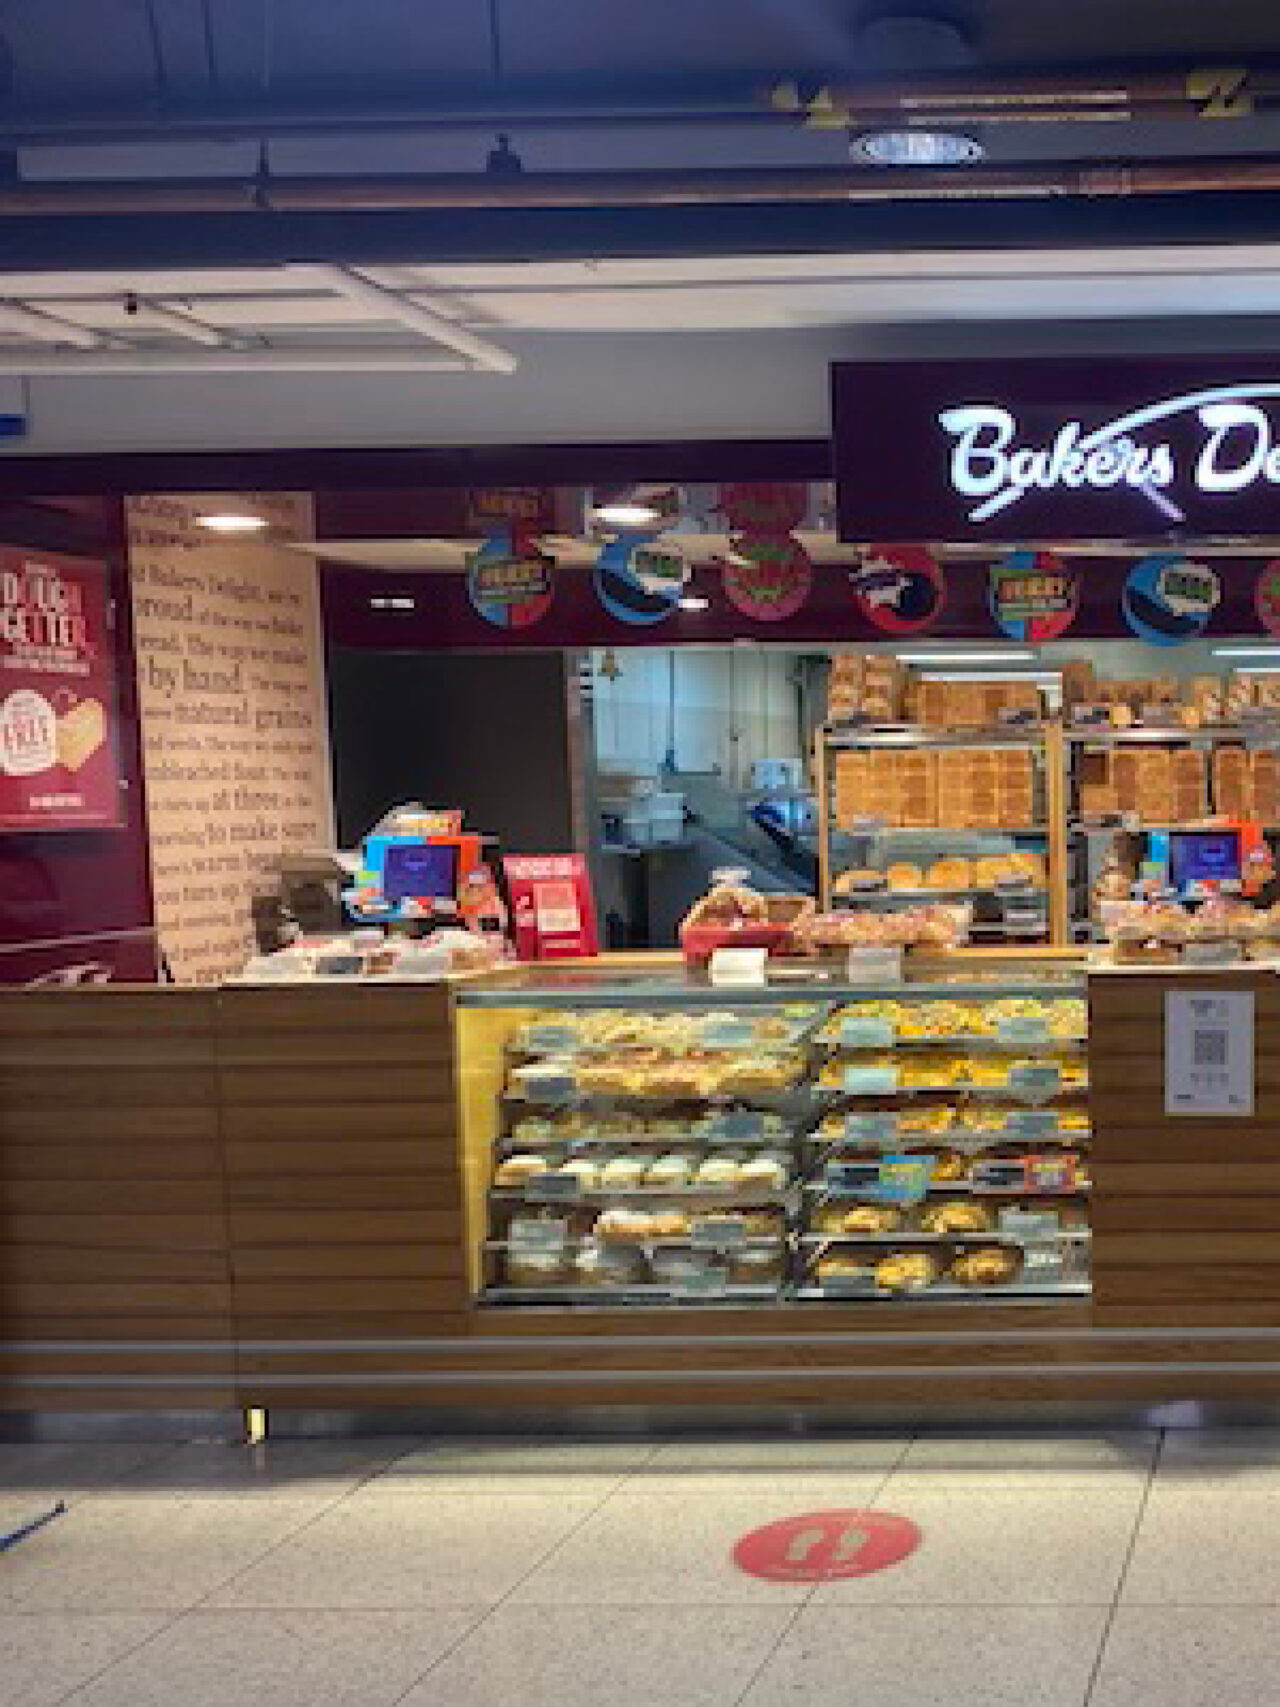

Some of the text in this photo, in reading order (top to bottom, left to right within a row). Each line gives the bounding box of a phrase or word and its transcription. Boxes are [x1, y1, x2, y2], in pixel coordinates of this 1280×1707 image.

[938, 407, 1176, 502] Bakers
[149, 655, 176, 698] by
[177, 699, 249, 727] natural
[255, 706, 313, 736] grains
[234, 786, 279, 811] three
[207, 824, 226, 842] to
[230, 817, 278, 842] make
